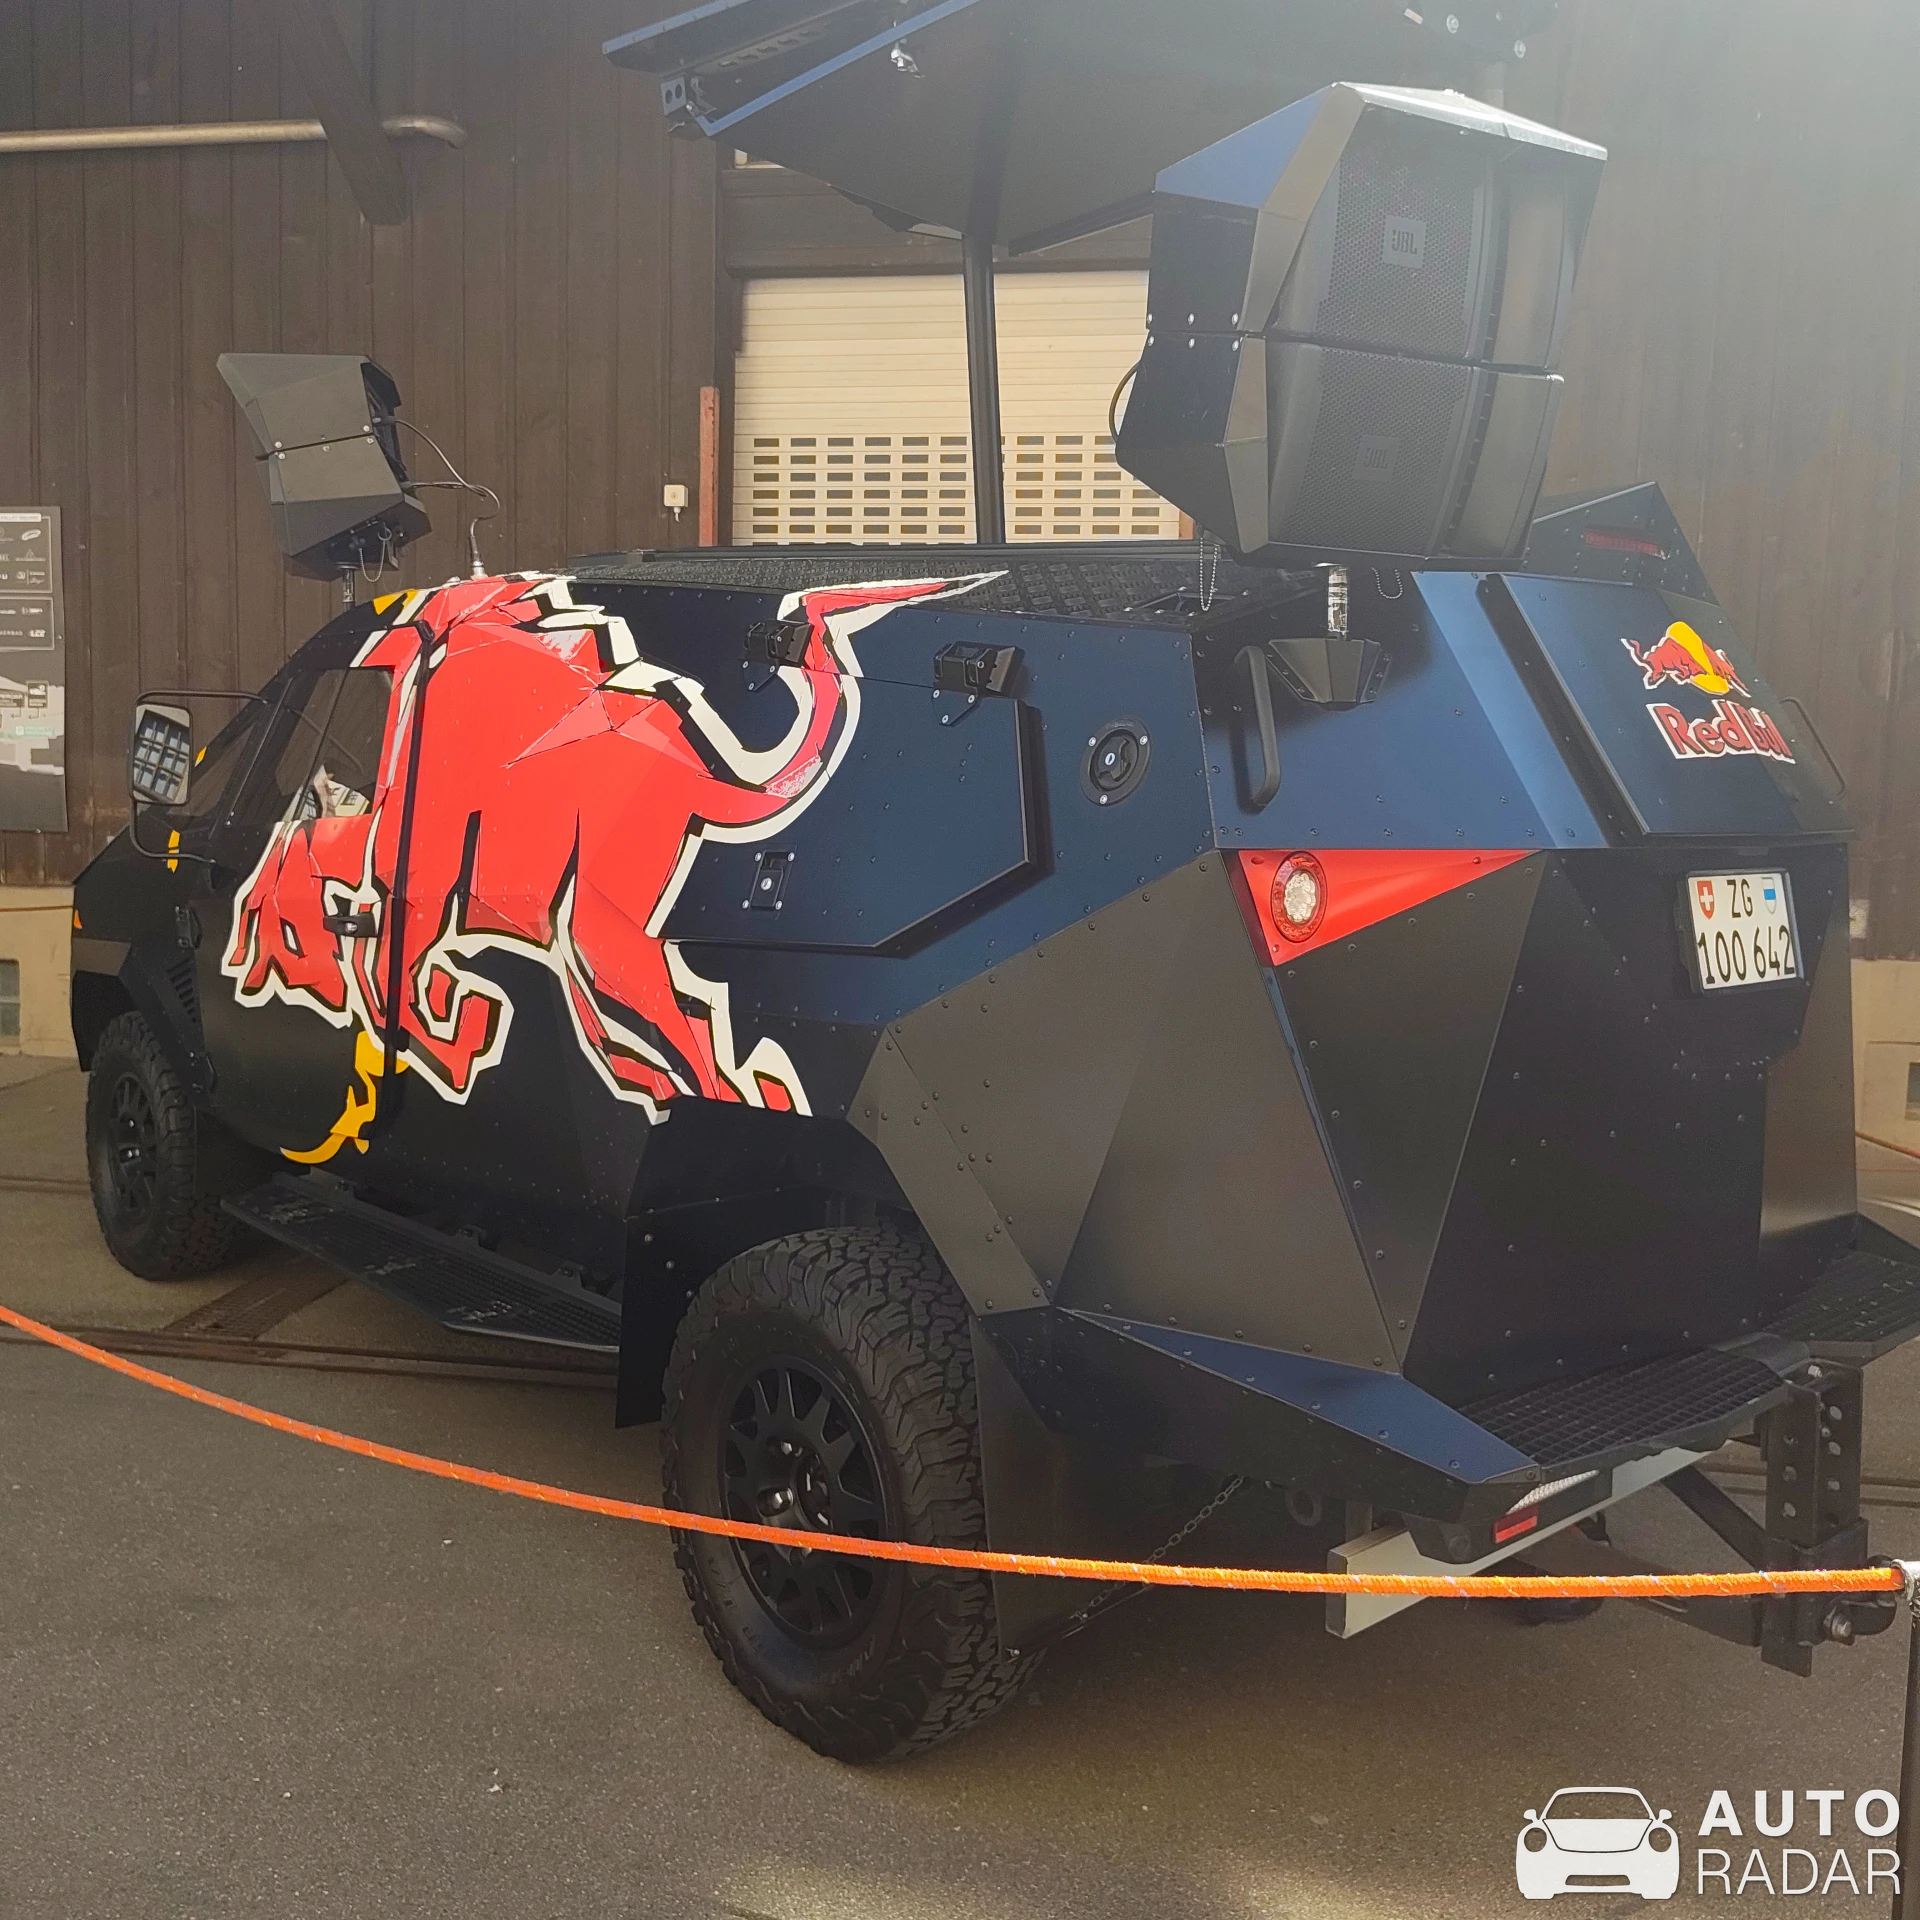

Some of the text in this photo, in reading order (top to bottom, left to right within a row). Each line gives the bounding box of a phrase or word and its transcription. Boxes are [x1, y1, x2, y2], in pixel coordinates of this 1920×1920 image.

[1391, 229, 1418, 255] JBL
[1362, 447, 1388, 470] JBL
[1652, 700, 1793, 758] Red Bull
[1726, 878, 1753, 918] ZG
[1697, 925, 1795, 984] 100 642
